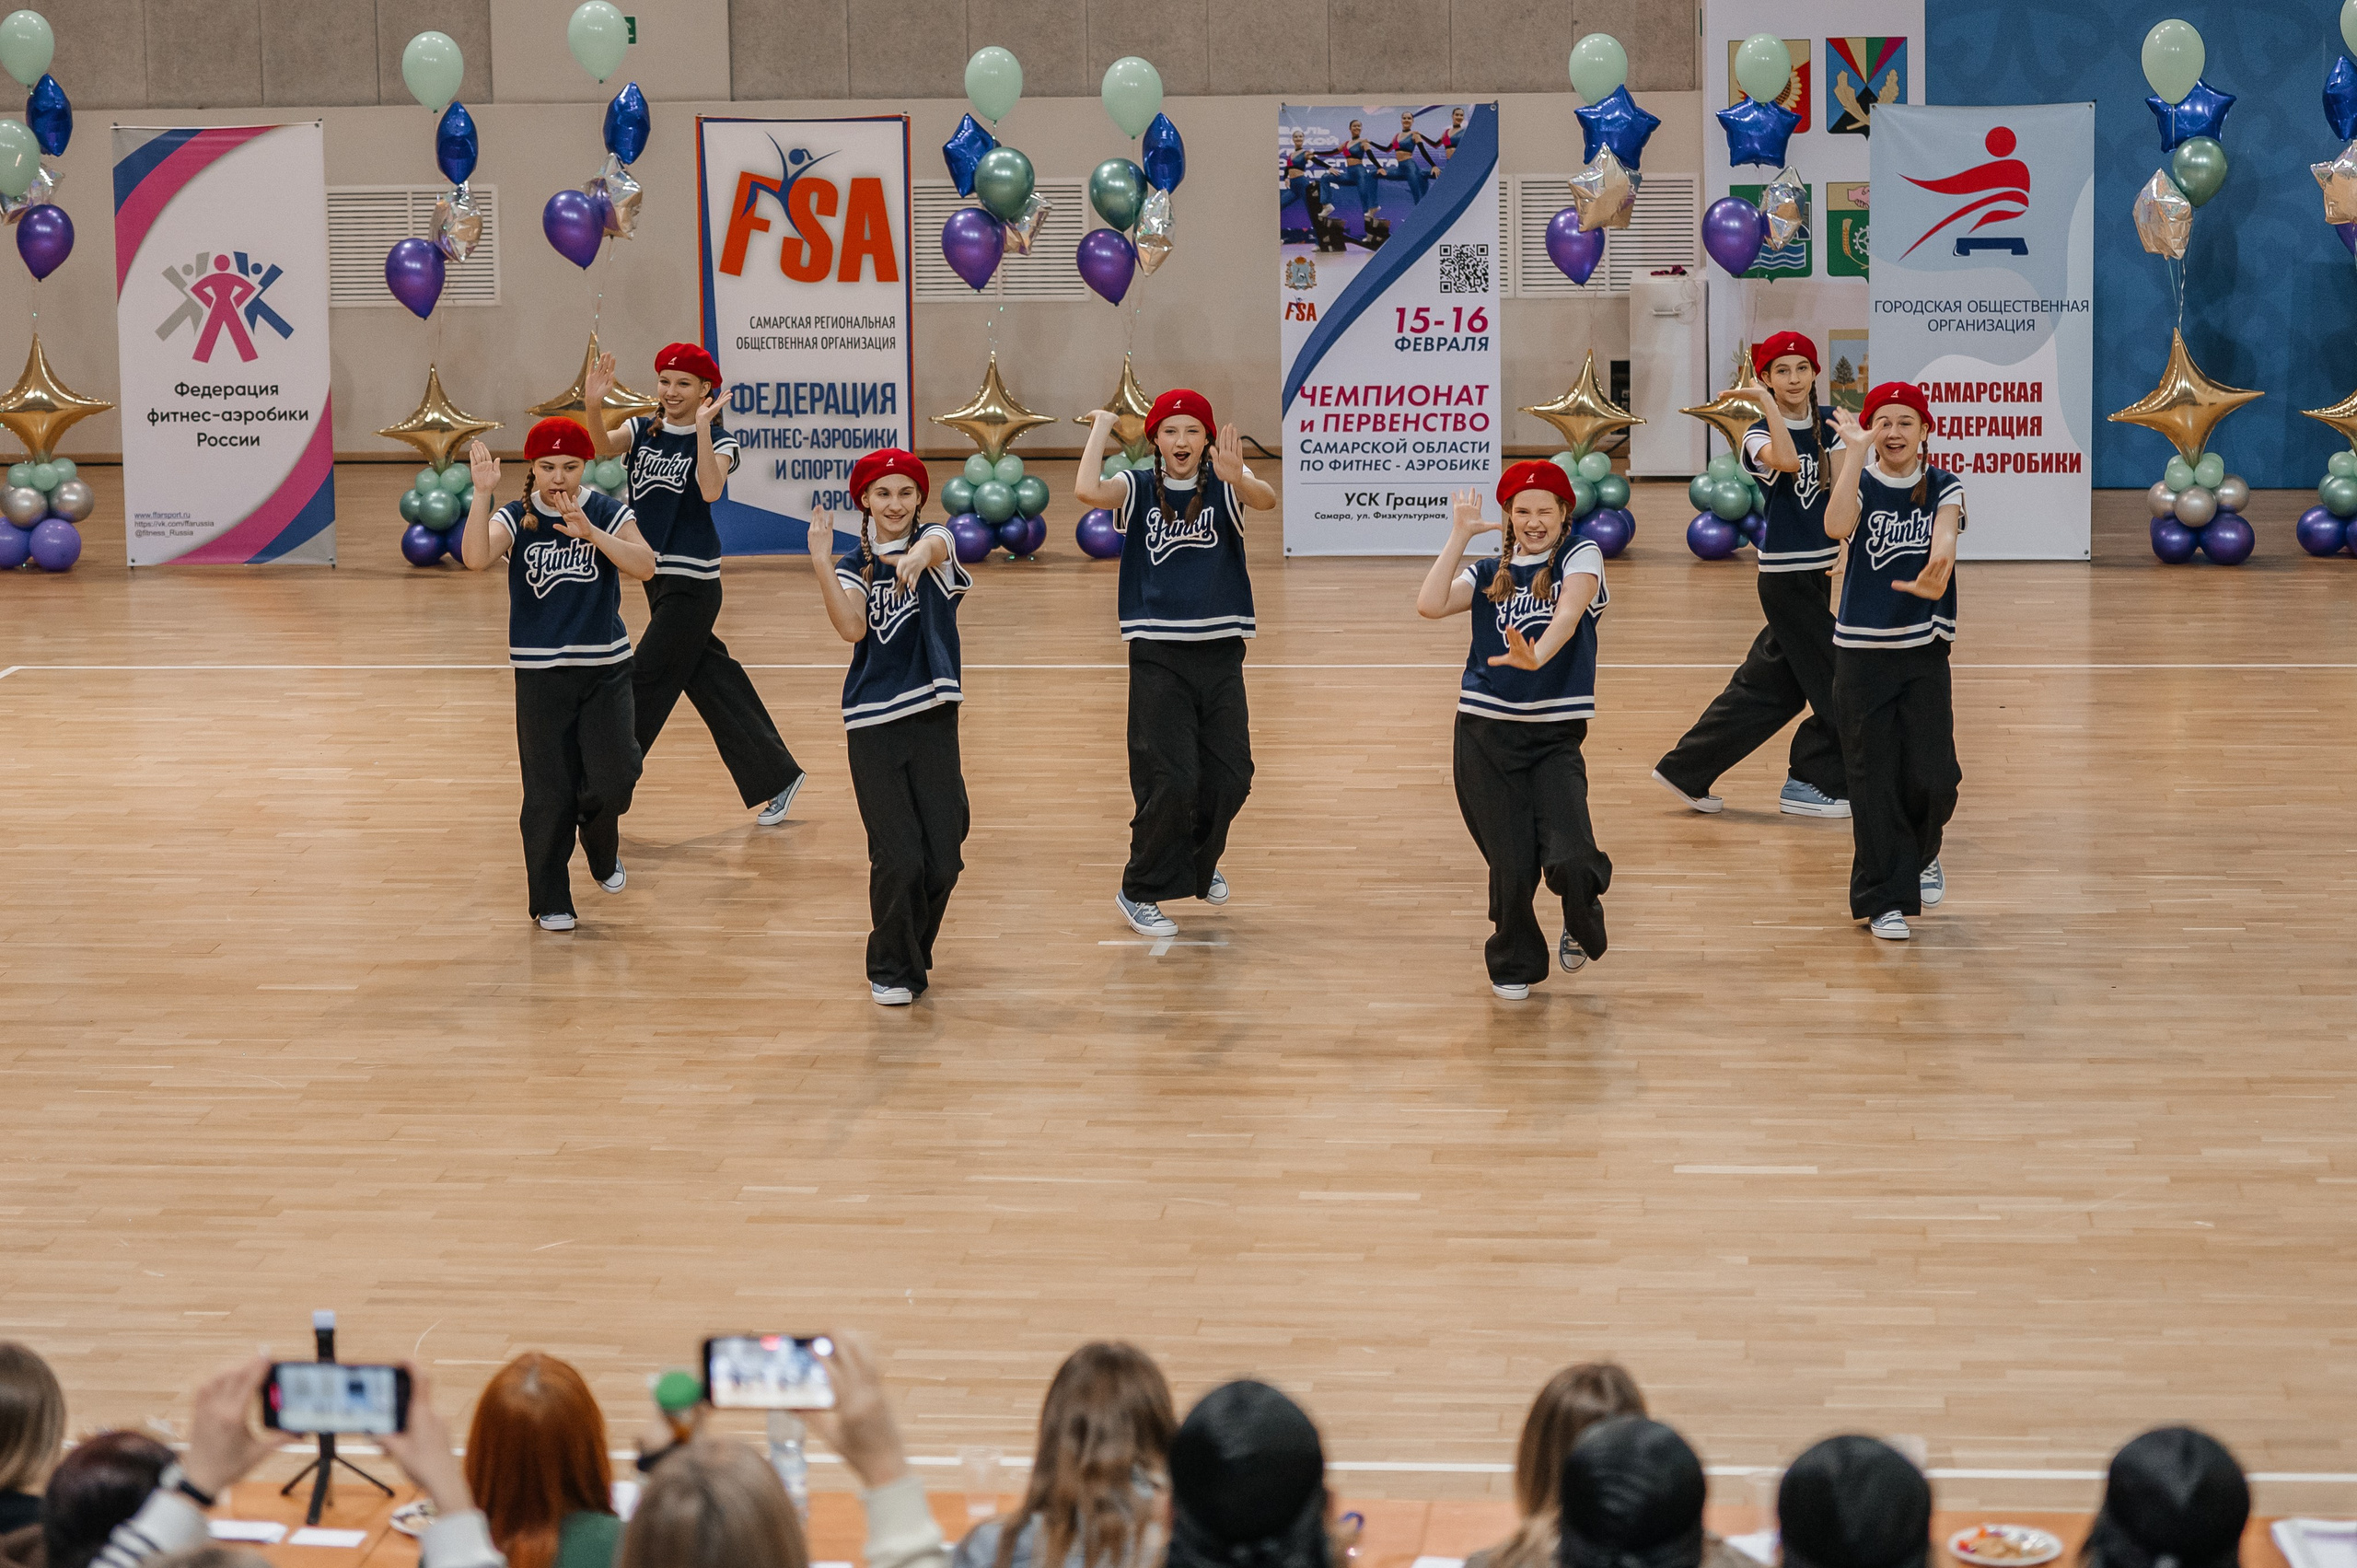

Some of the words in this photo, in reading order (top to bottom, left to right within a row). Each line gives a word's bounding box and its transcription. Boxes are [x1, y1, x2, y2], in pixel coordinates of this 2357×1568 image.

[719, 171, 899, 283] FSA
[1284, 301, 1318, 321] FSA
[1875, 300, 1962, 315] ГОРОДСКАЯ
[1967, 299, 2089, 315] ОБЩЕСТВЕННАЯ
[749, 316, 812, 330] САМАРСКАЯ
[814, 316, 896, 330] РЕГИОНАЛЬНАЯ
[1395, 306, 1489, 333] 15-16
[1927, 319, 2036, 333] ОРГАНИЗАЦИЯ
[736, 336, 819, 351] ОБЩЕСТВЕННАЯ
[820, 336, 896, 352] ОРГАНИЗАЦИЯ
[1394, 335, 1490, 352] ФЕВРАЛЯ
[174, 381, 279, 400] Федерация
[730, 382, 897, 418] ФЕДЕРАЦИЯ
[1300, 384, 1490, 407] ЧЕМПИОНАТ
[146, 406, 309, 426] фитнес-аэробики
[1300, 420, 1315, 433] и
[1322, 412, 1491, 433] ПЕРВЕНСТВО
[1929, 415, 2043, 440] ЕДЕРАЦИЯ
[196, 433, 261, 447] России
[734, 428, 898, 449] ФИТНЕС-АЭРОБИКИ
[1411, 441, 1490, 454] ОБЛАСТИ
[775, 459, 789, 480] И
[791, 459, 858, 481] СПОРТИ
[1300, 459, 1324, 471] ПО
[1329, 459, 1392, 471] ФИТНЕС
[1405, 459, 1491, 471] АЭРОБИКЕ
[1918, 452, 2082, 473] НЕС-АЭРОБИКИ
[631, 446, 693, 501] Funky
[811, 490, 857, 511] АЭРО
[1344, 493, 1380, 506] УСК
[1385, 493, 1448, 510] Грация
[1314, 512, 1353, 521] Самара,
[1356, 513, 1371, 521] ул.
[1373, 511, 1449, 521] Физкультурная,
[524, 538, 598, 598] Funky
